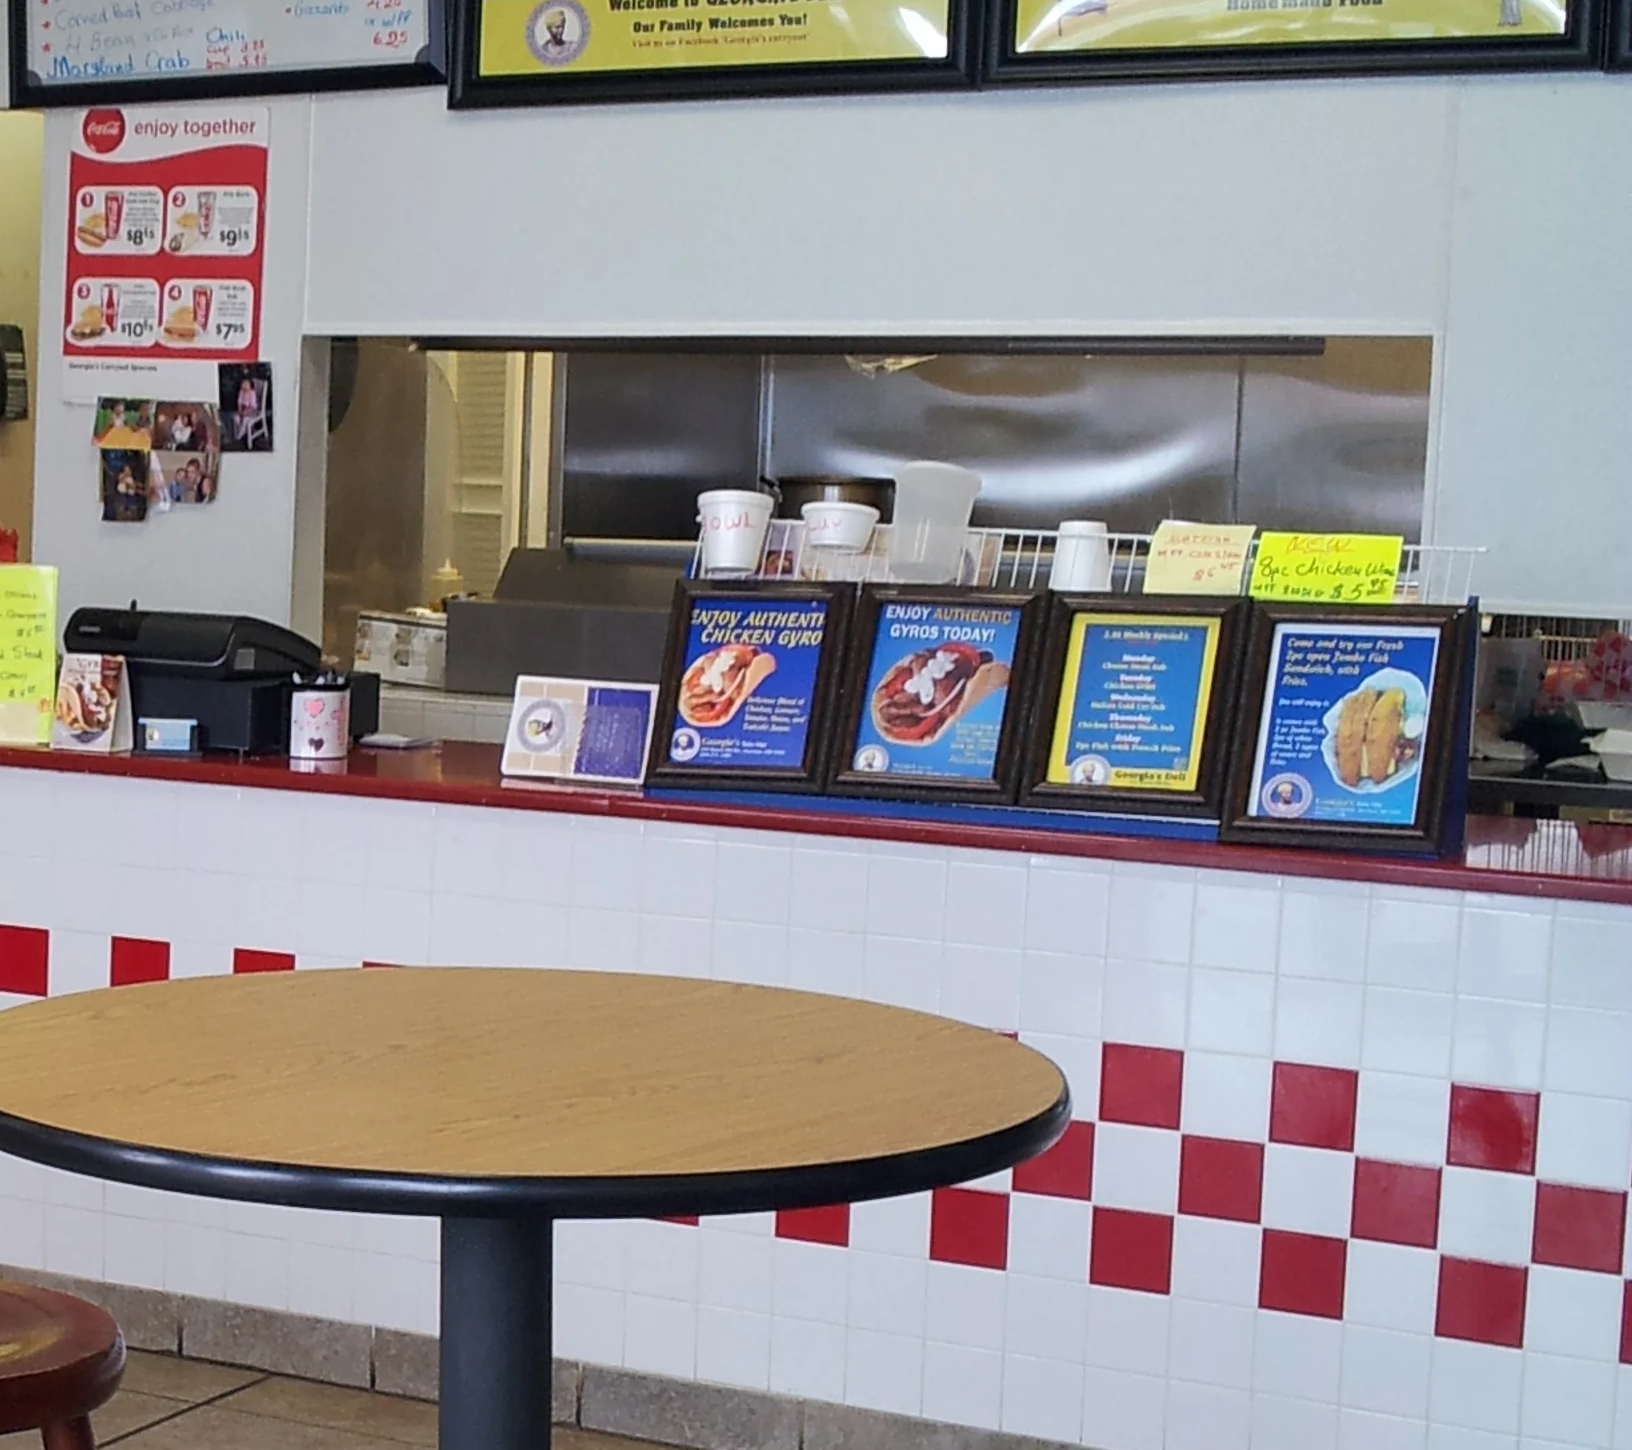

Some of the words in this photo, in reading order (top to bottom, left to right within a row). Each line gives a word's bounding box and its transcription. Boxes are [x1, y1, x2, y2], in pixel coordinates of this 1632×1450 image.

[633, 20, 655, 34] Our
[659, 18, 703, 33] Family
[708, 16, 775, 30] Welcomes
[778, 13, 808, 26] You!
[47, 54, 134, 78] Maryland
[145, 49, 190, 70] Crab
[133, 119, 180, 137] enjoy
[183, 117, 256, 136] together
[691, 609, 741, 627] ENJOY
[743, 610, 825, 627] AUTHENTI
[886, 605, 931, 620] ENJOY
[934, 608, 1012, 625] AUTHENTIC
[701, 628, 773, 644] CHICKEN
[890, 623, 938, 639] GYROS
[943, 626, 995, 642] TODAY!
[1287, 638, 1314, 648] Come
[1316, 638, 1336, 649] and
[1368, 652, 1390, 664] Fish
[1338, 665, 1360, 675] with
